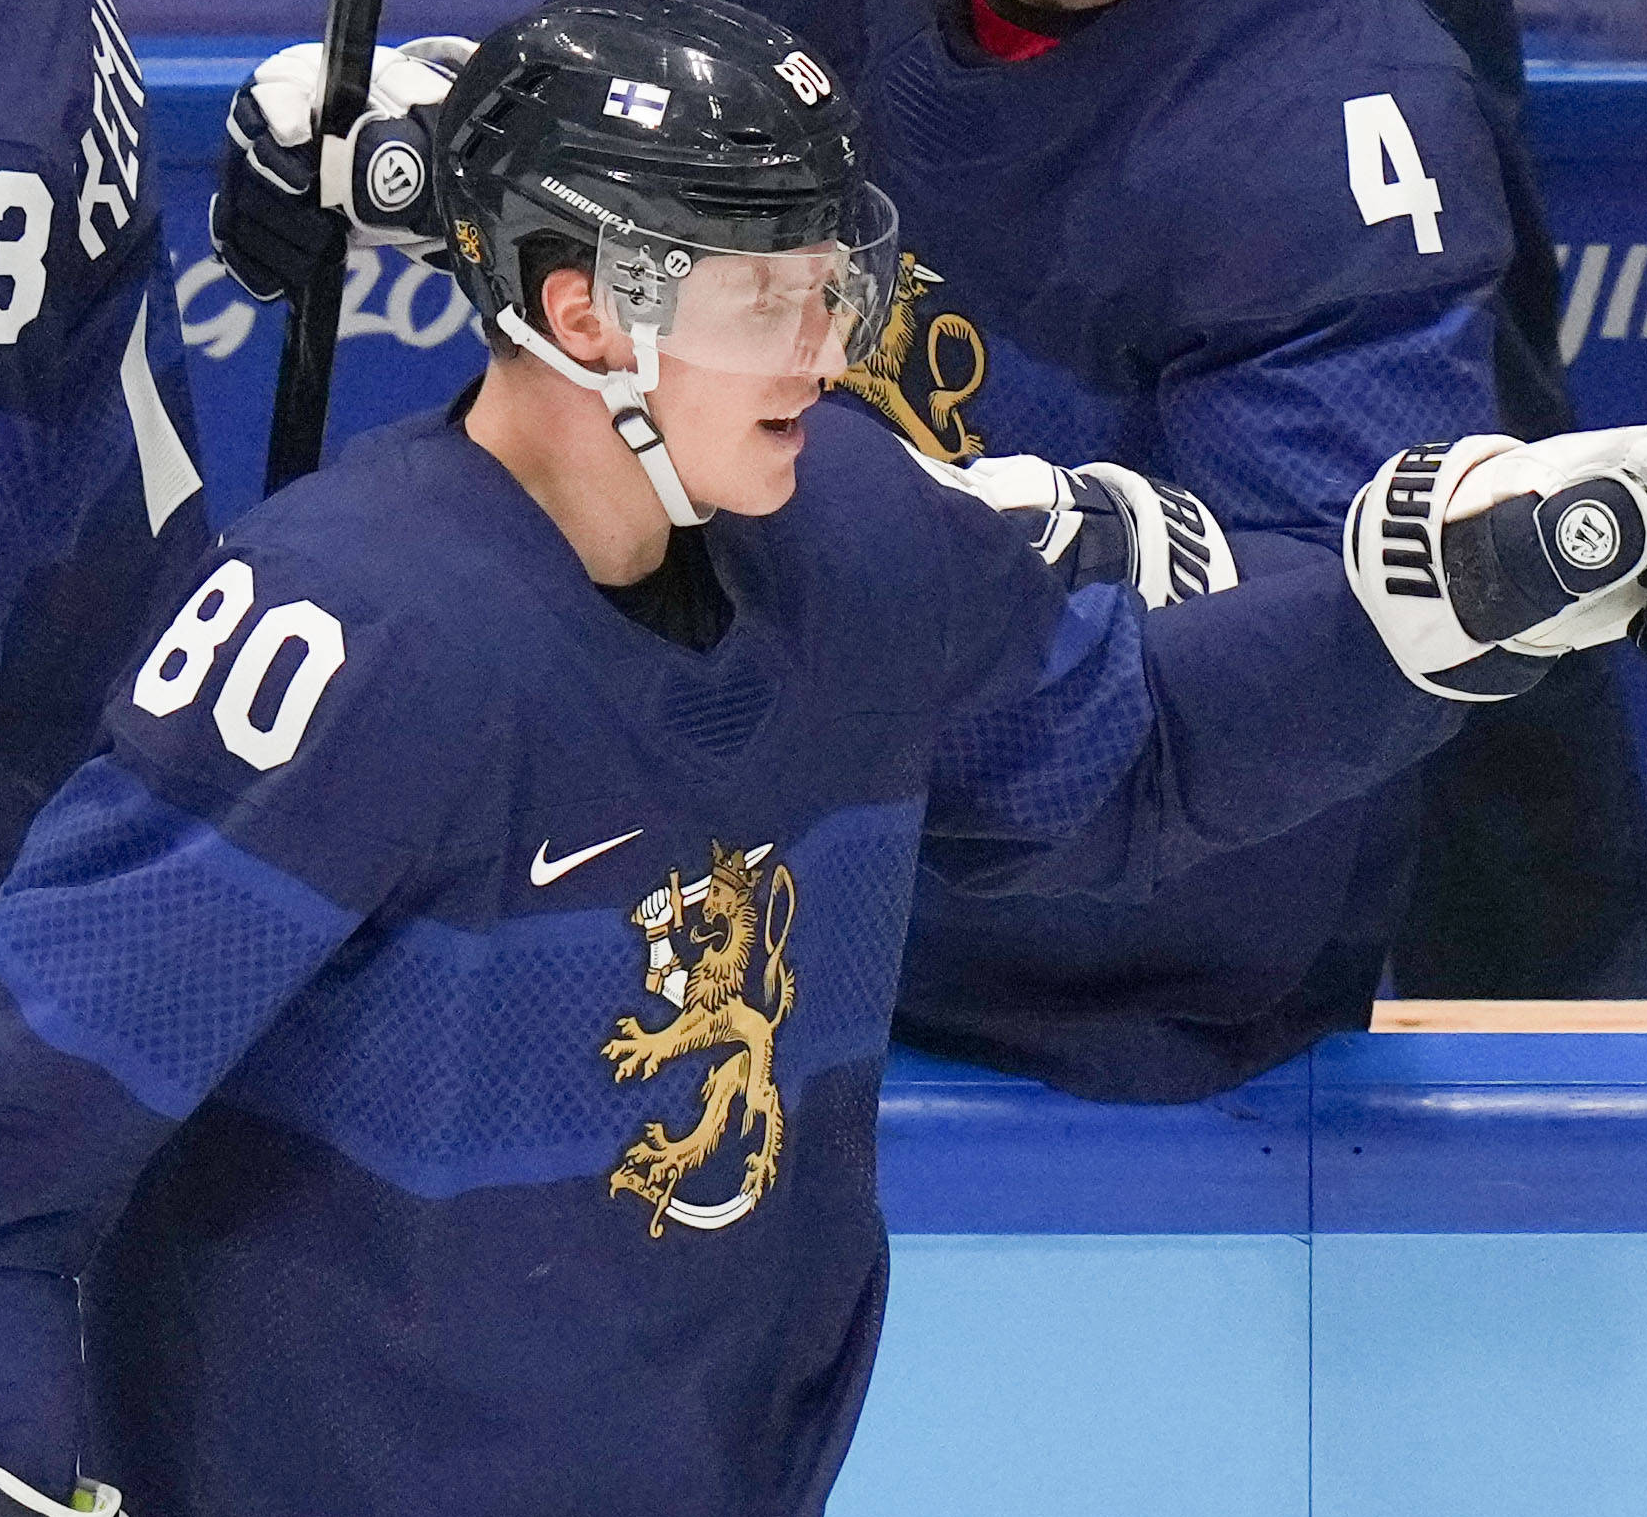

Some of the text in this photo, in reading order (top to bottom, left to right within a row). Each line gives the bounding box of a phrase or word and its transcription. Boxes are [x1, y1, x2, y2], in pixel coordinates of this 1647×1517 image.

[774, 49, 834, 106] 80
[1342, 92, 1445, 254] 4
[133, 559, 346, 774] 80
